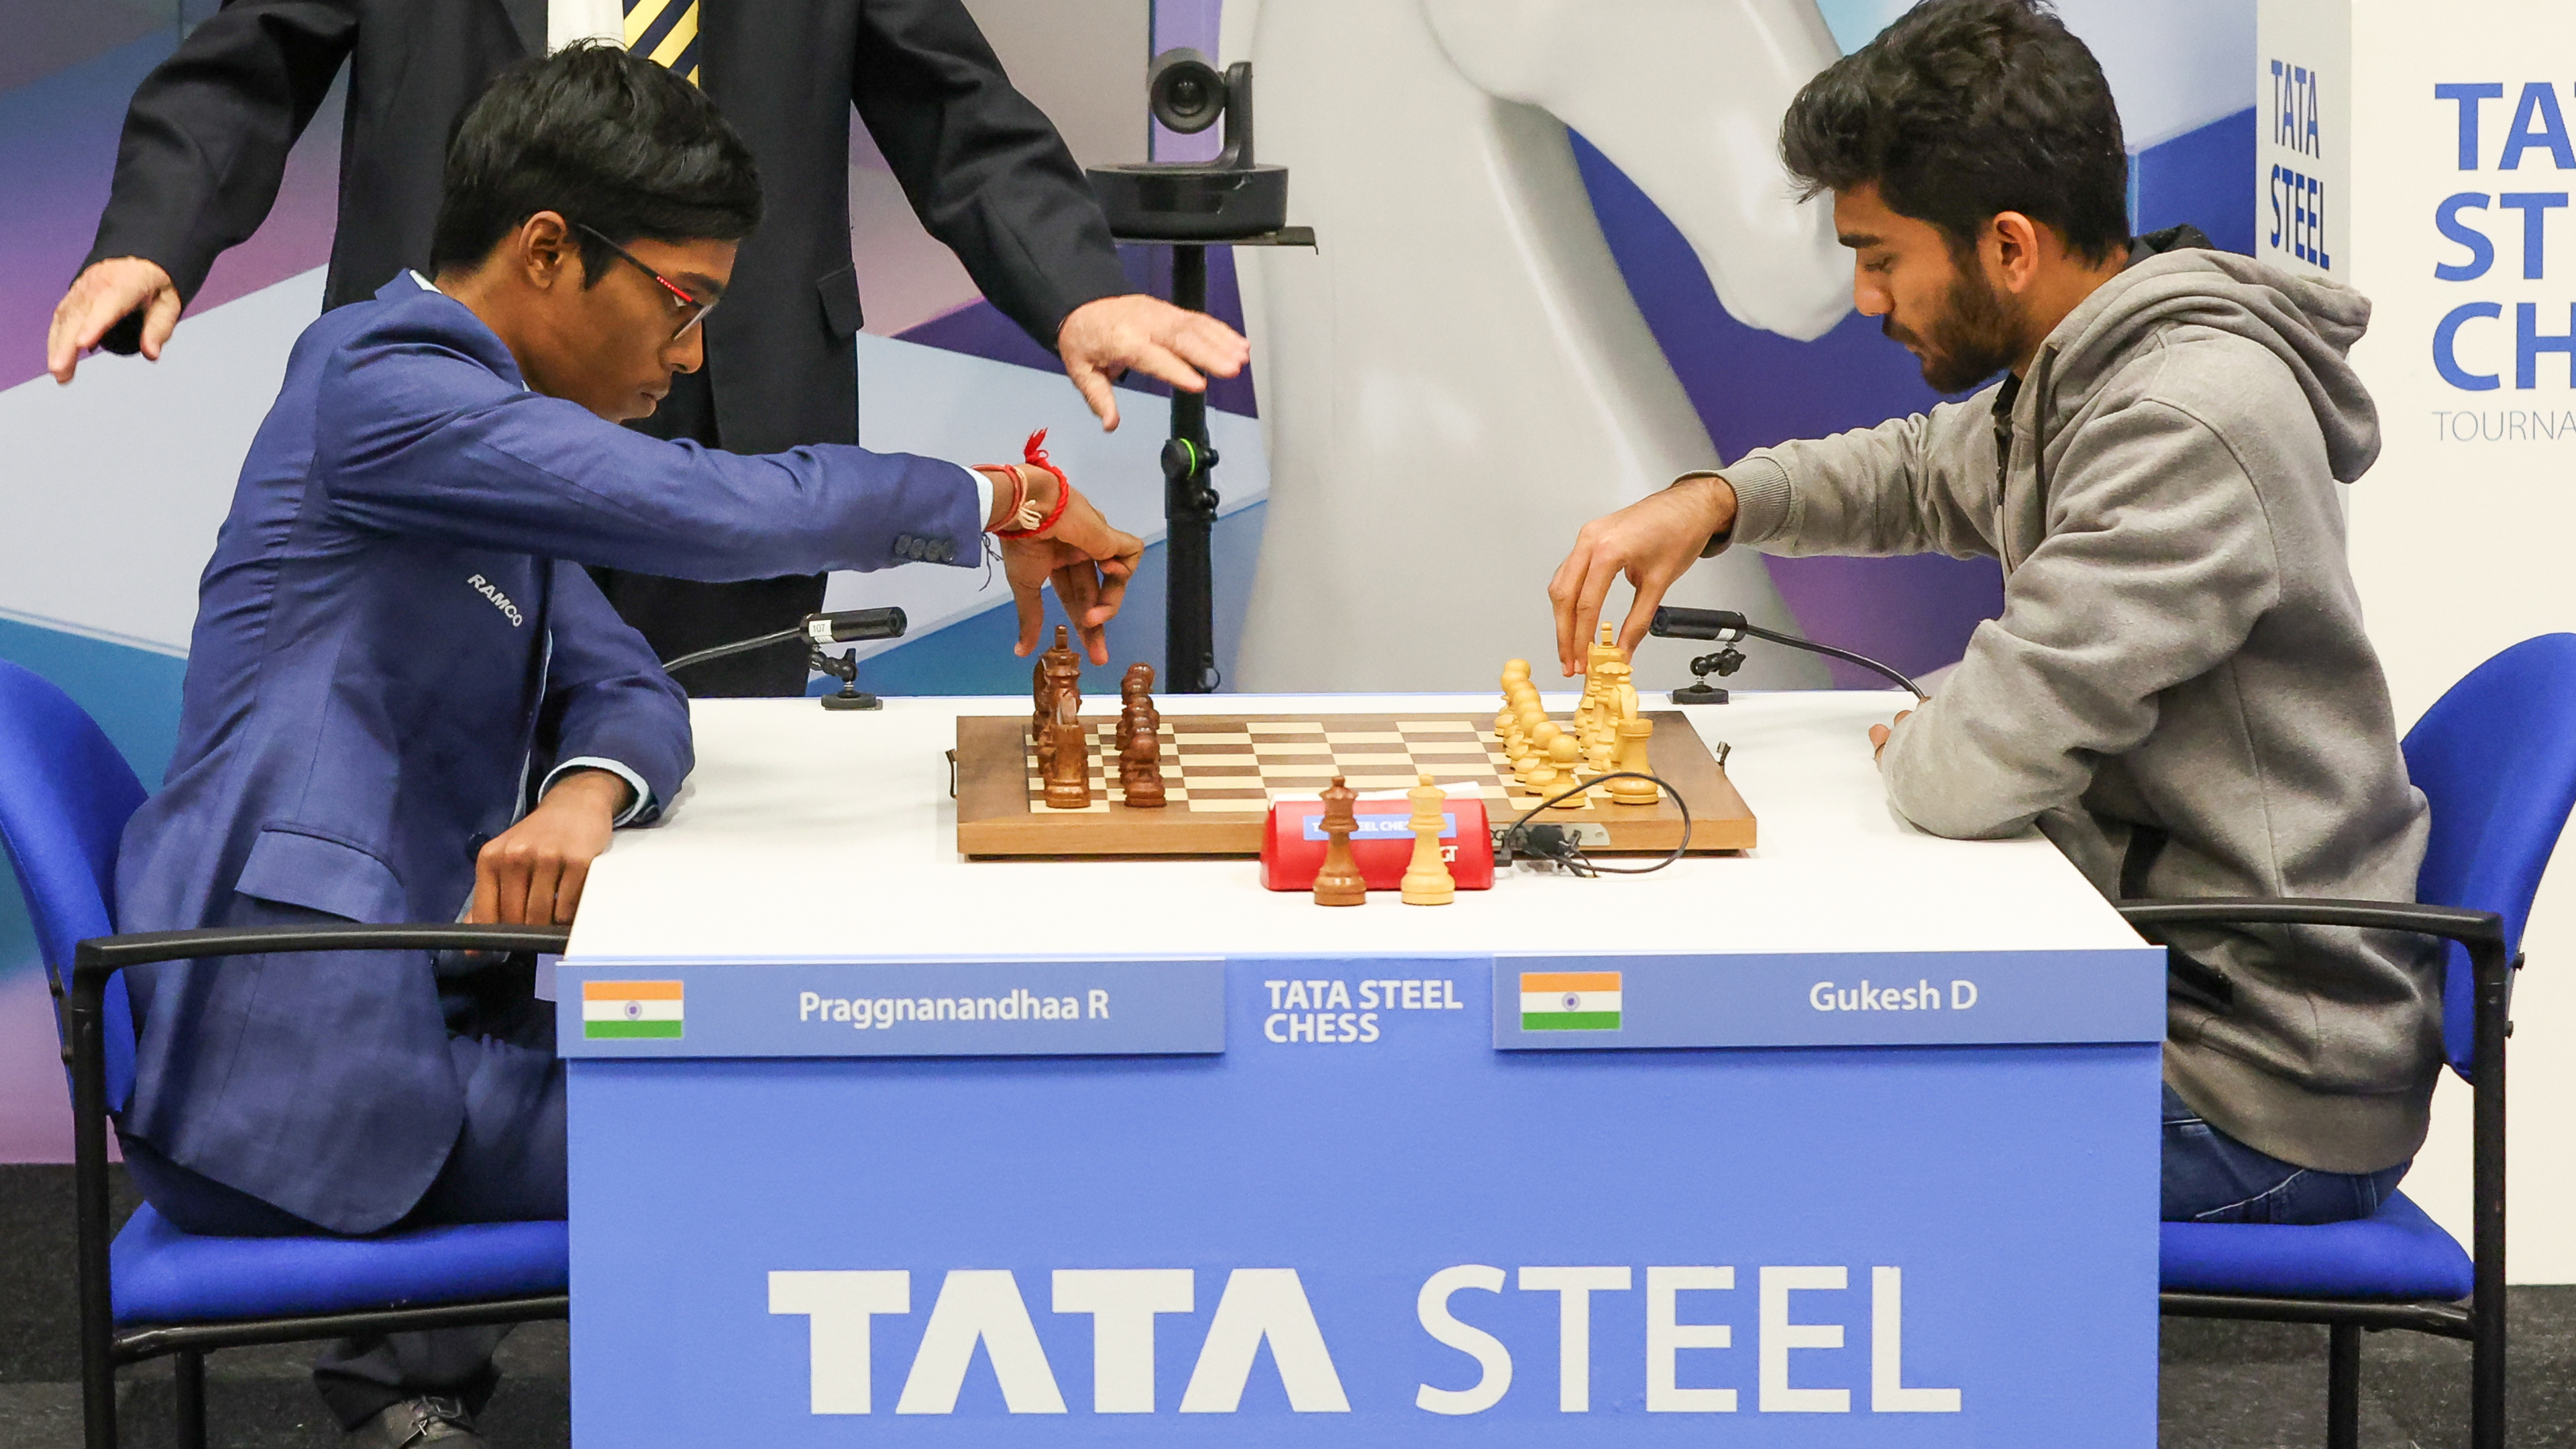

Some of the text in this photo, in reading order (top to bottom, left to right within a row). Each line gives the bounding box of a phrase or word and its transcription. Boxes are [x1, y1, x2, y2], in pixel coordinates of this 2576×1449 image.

[2271, 59, 2320, 159] TATA
[2434, 82, 2576, 171] TA
[2271, 164, 2330, 271] STEEL
[2432, 301, 2576, 391] CH
[467, 574, 523, 627] RAMCO
[812, 624, 826, 633] 107
[1379, 820, 1409, 832] CHE
[1439, 845, 1459, 863] GT
[799, 988, 1110, 1029] Praggnanandhaa R
[1264, 979, 1464, 1010] TATA STEEL
[1809, 978, 1978, 1012] Gukesh D
[1264, 1012, 1381, 1043] CHESS
[767, 1264, 1962, 1415] TATA STEEL
